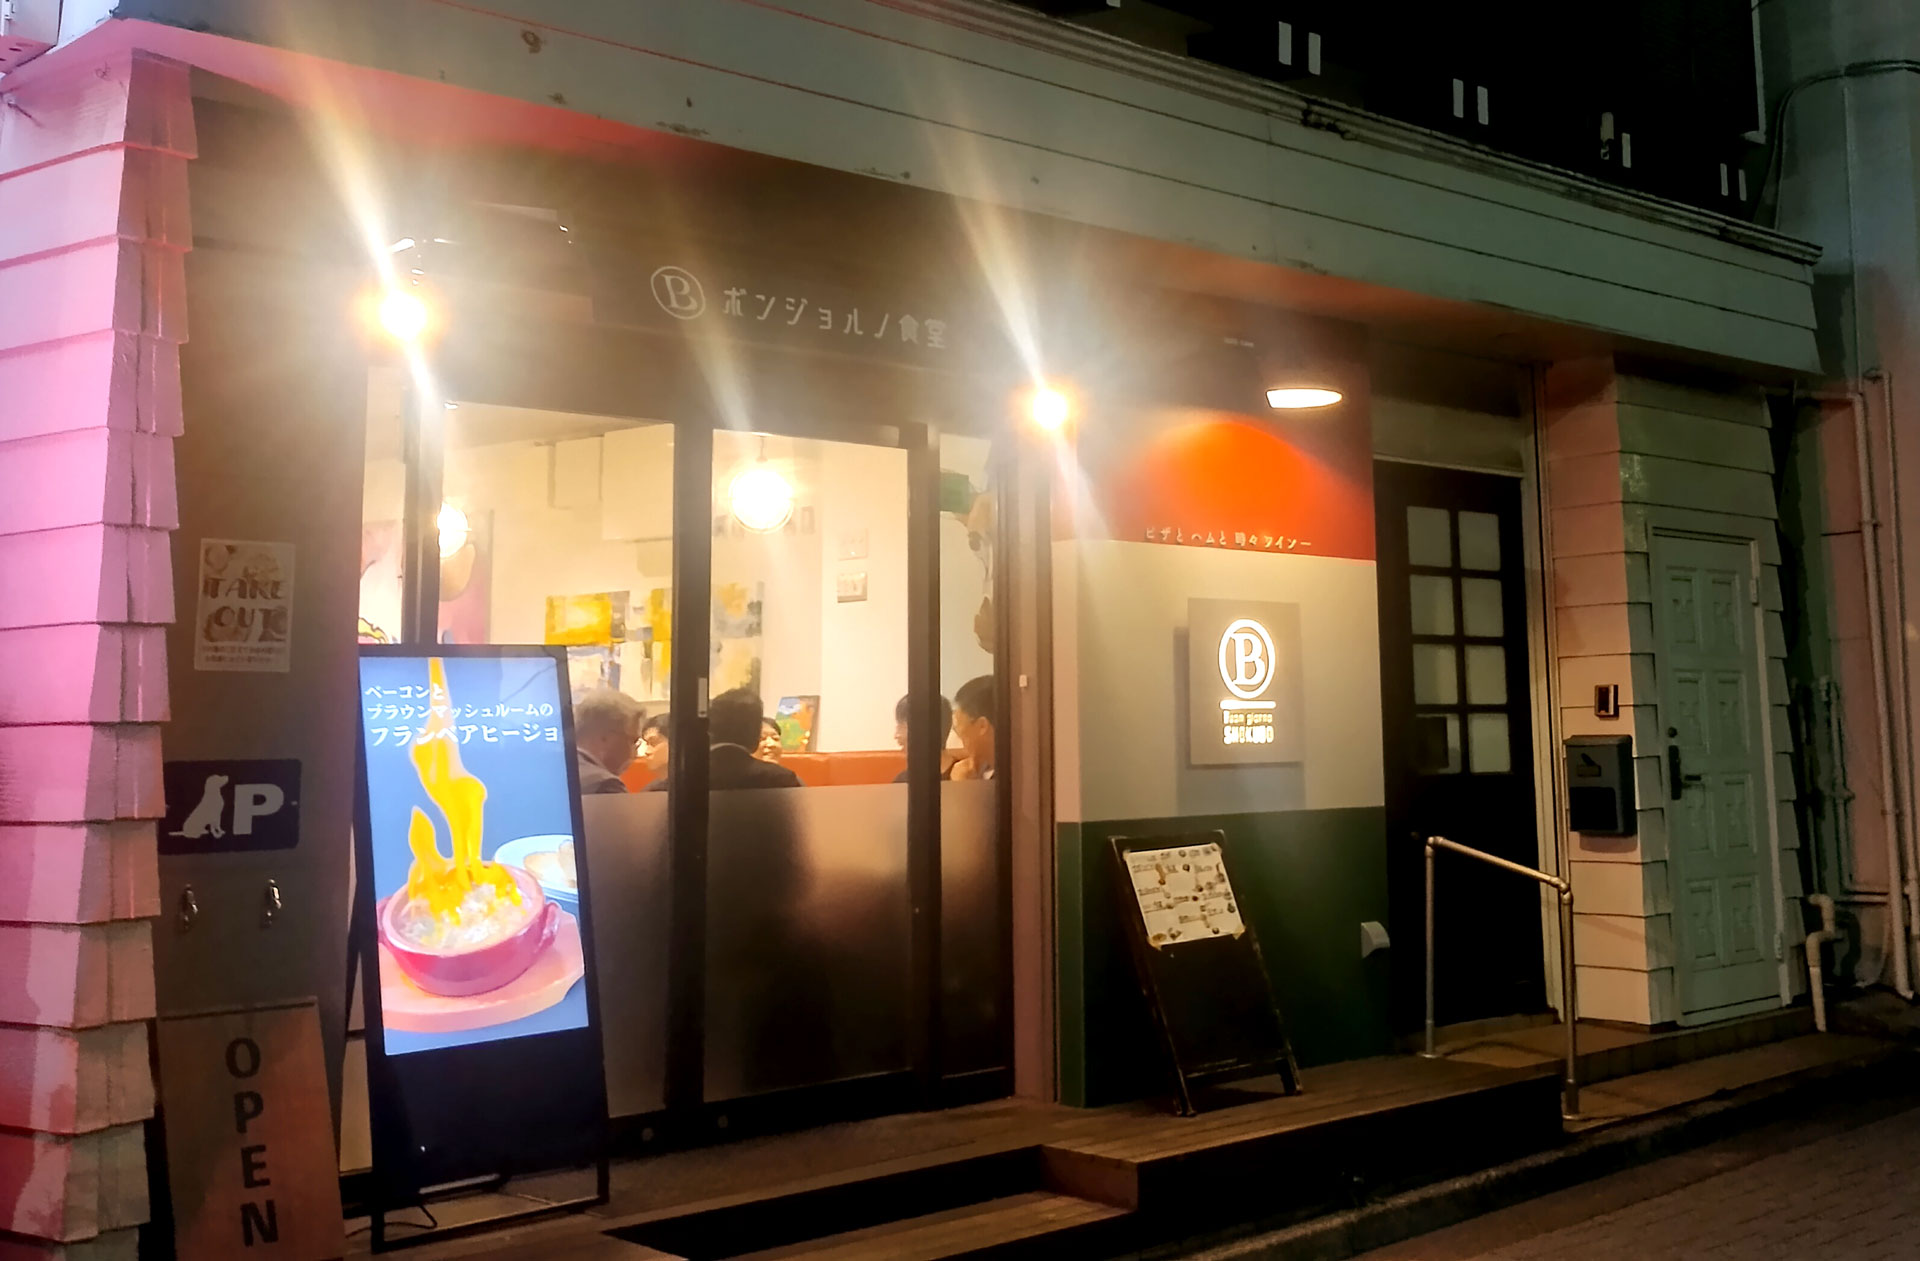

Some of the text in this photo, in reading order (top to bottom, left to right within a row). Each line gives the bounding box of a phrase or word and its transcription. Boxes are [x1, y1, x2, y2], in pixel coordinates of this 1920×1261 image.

[723, 286, 947, 349] ボンジョルノ食堂
[208, 576, 284, 600] TAKE
[364, 683, 446, 700] ベーコンと
[367, 702, 554, 721] ブラウンマッシュルームの
[370, 722, 559, 747] フランベアヒージョ
[232, 783, 285, 835] P
[225, 1036, 280, 1248] OPEN
